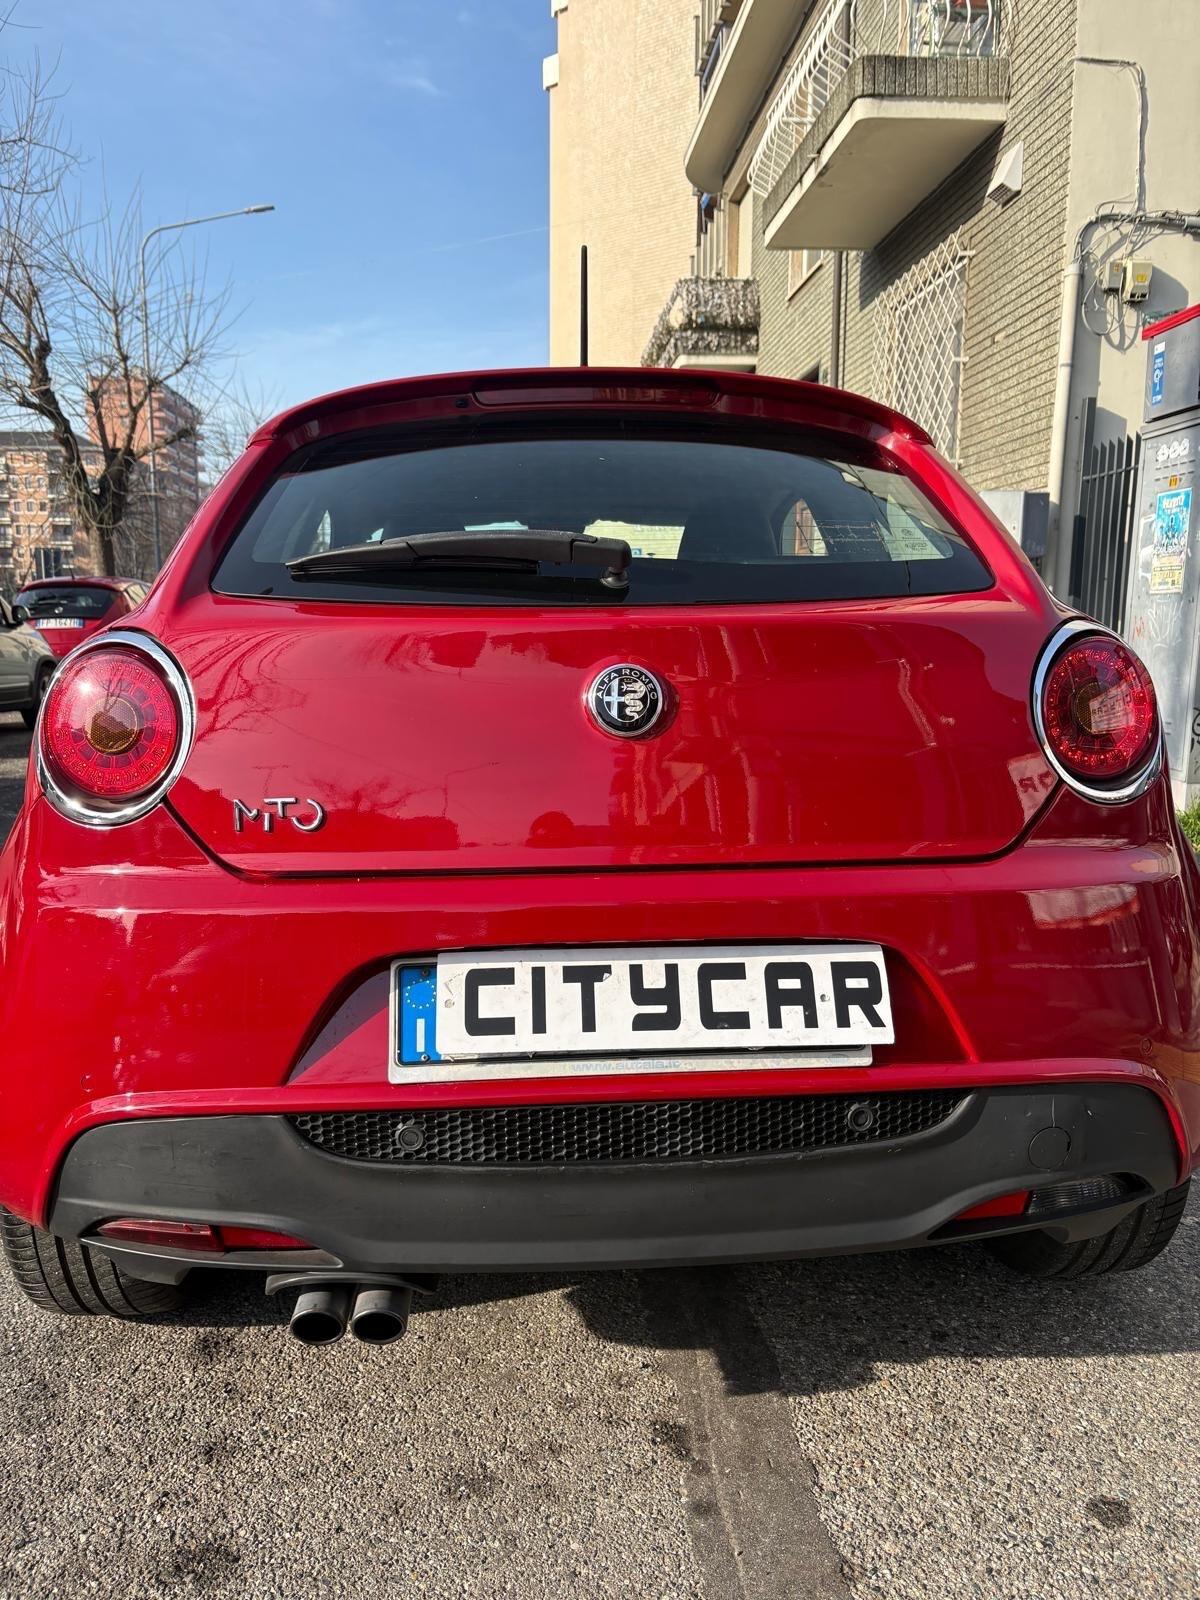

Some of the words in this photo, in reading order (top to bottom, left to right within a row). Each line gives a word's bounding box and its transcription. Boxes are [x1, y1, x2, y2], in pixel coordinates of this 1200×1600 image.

[596, 672, 619, 700] ALFA
[621, 668, 658, 700] ROMEO
[464, 961, 887, 1037] CITYCAR
